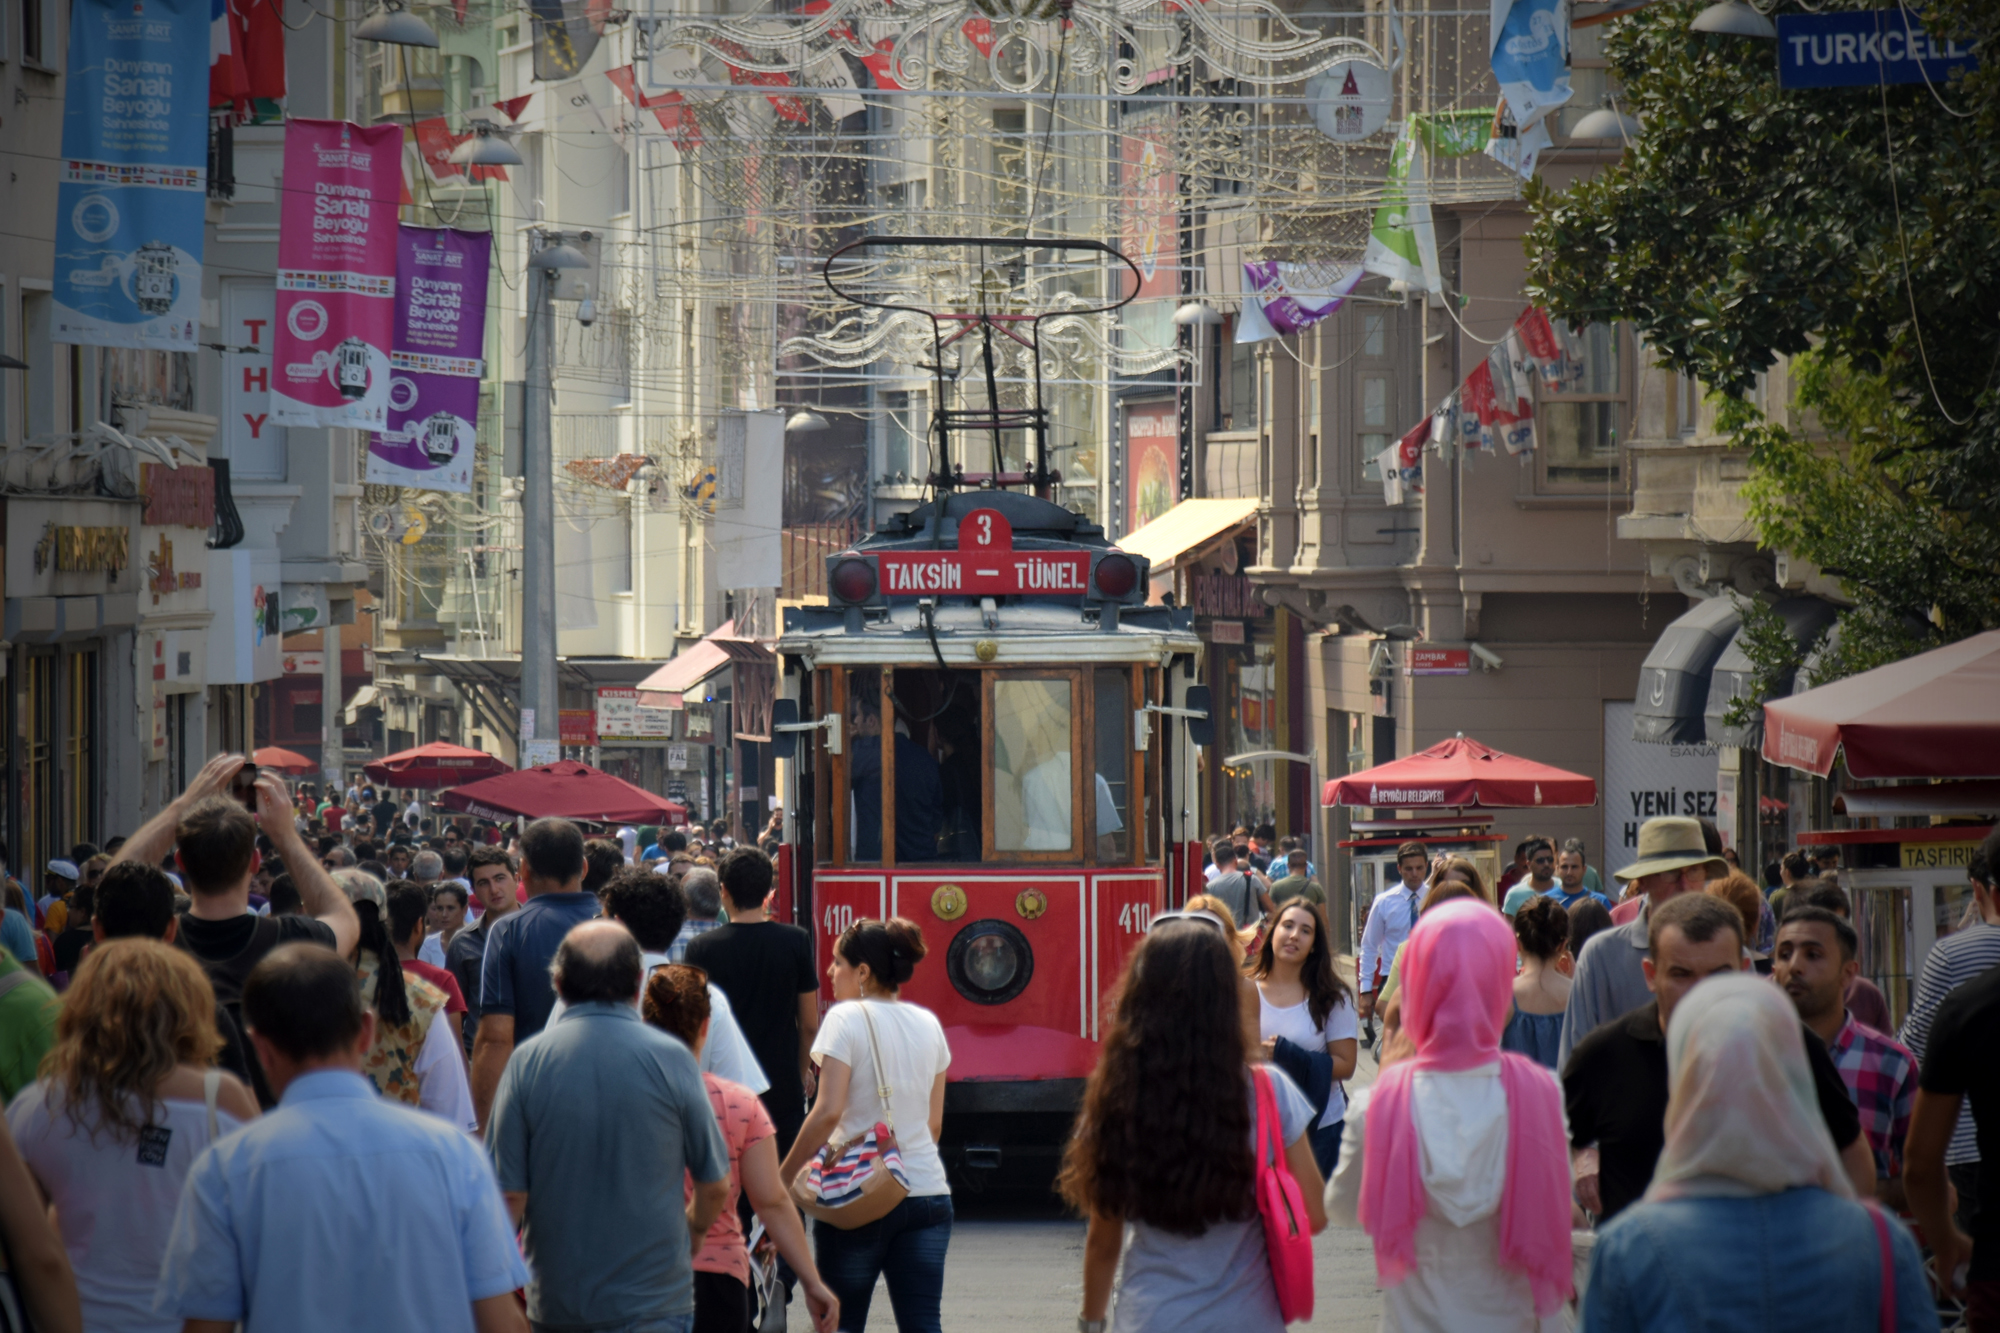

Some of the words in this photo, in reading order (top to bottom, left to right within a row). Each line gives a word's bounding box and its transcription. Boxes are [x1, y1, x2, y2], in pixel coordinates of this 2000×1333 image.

[108, 24, 141, 35] SANAT
[146, 24, 172, 37] ART
[1788, 30, 1968, 67] TURKCELL
[104, 57, 173, 76] Dünyanın
[103, 73, 172, 98] Sanatı
[102, 96, 171, 118] Beyoğlu
[102, 116, 170, 131] Sahnesinde
[318, 153, 349, 163] SANAT
[351, 155, 371, 167] ART
[315, 182, 371, 199] Dünyanın
[314, 195, 370, 219] Sanatı
[313, 215, 369, 234] Beyoğlu
[313, 232, 367, 246] Sahnesinde
[415, 252, 443, 261] SANAT
[444, 255, 463, 264] ART
[411, 276, 463, 292] Dünyanın
[410, 288, 461, 309] Sanatı
[409, 304, 460, 323] Beyoğlu
[407, 319, 459, 333] Sahnesinde
[243, 319, 268, 439] THY
[977, 515, 992, 545] 3
[886, 558, 962, 590] TAKSİM
[1014, 558, 1085, 589] TÜNEL
[1415, 652, 1447, 661] ZAMBAK
[670, 753, 686, 762] FAL
[1670, 747, 1717, 758] SANA
[1379, 788, 1407, 803] BEYOĞLU
[1407, 789, 1444, 803] BELEDİYESİ
[1630, 786, 1676, 817] YENİ
[1683, 791, 1717, 817] SEZ
[824, 904, 853, 936] 410
[1118, 902, 1151, 935] 410
